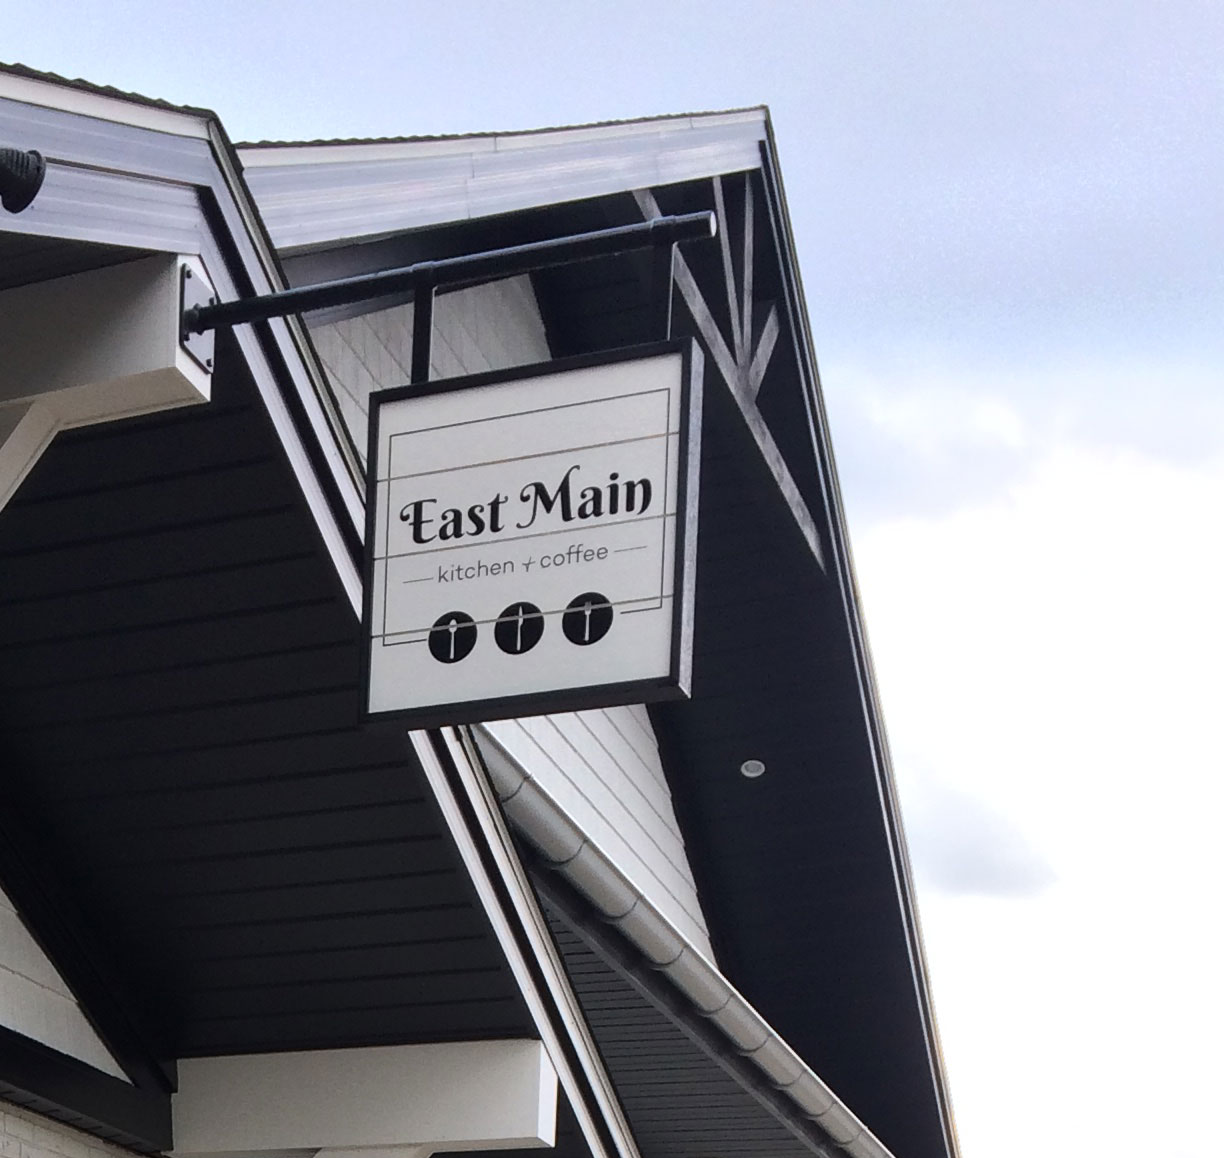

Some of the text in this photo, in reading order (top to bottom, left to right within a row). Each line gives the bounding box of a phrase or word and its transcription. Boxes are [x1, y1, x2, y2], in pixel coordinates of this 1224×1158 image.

[399, 464, 653, 545] East Main
[437, 558, 515, 584] kitchen
[539, 544, 609, 569] coffee
